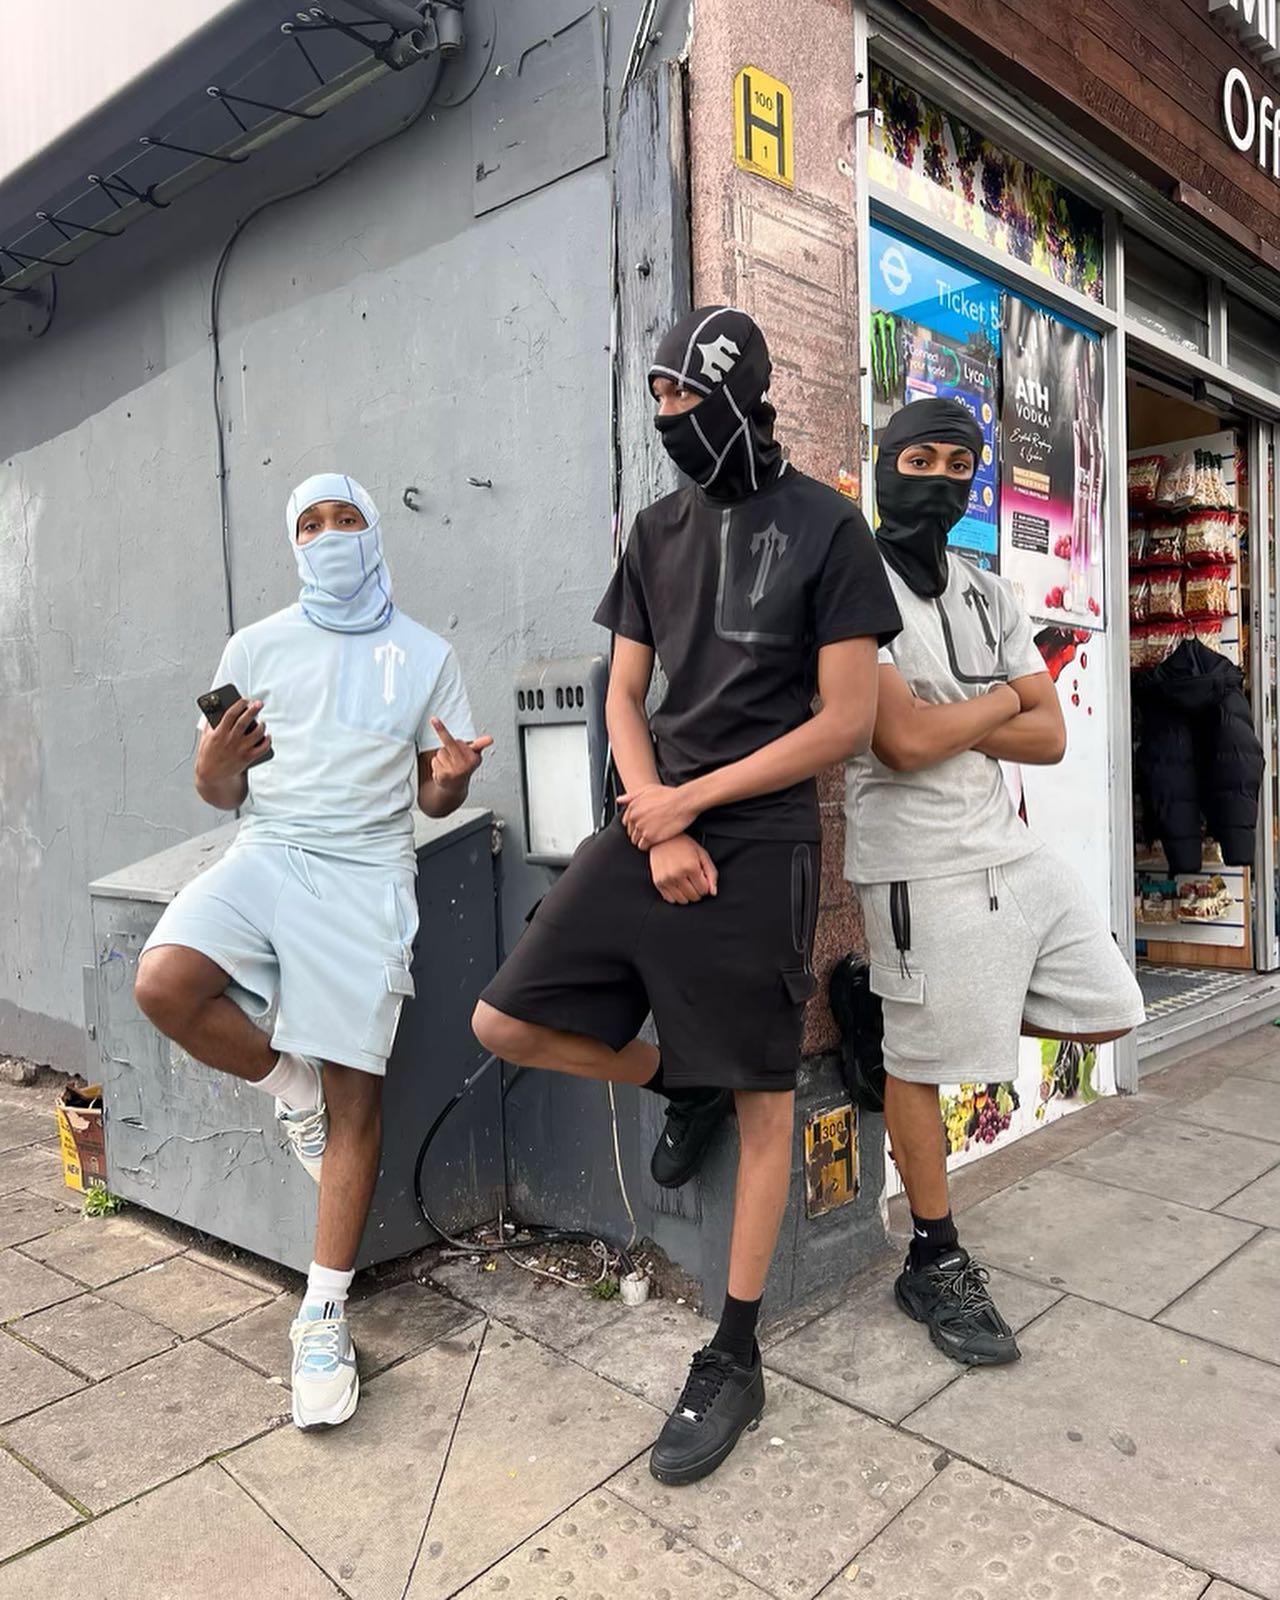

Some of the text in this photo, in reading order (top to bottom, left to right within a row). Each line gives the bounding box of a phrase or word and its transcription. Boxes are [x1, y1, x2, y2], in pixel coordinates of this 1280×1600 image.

[755, 91, 772, 111] 100
[743, 73, 785, 176] H
[763, 145, 768, 159] 1
[936, 279, 985, 325] Ticket
[964, 362, 985, 386] Lyca
[1015, 375, 1049, 411] ATH
[1016, 402, 1050, 428] VODKA
[822, 1121, 845, 1139] 300
